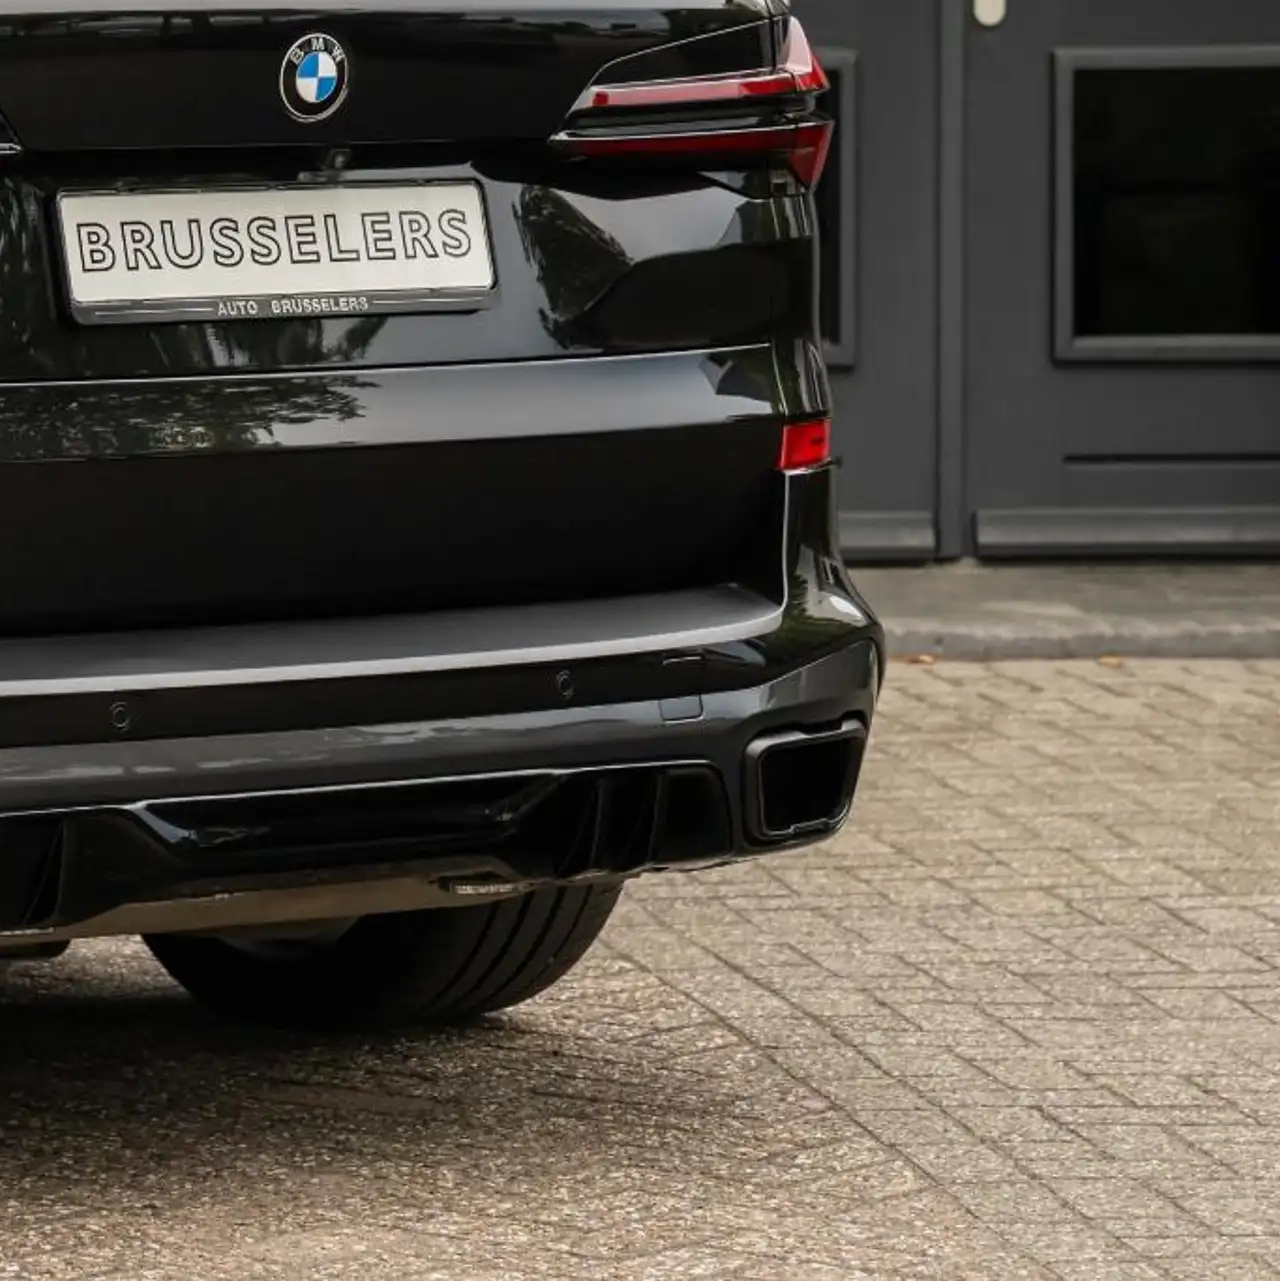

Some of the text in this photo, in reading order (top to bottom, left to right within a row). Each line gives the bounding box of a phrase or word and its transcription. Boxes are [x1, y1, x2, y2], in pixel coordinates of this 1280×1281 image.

[75, 208, 472, 273] BRUSSELERS
[217, 296, 369, 317] AUTO BRUSSELERS
